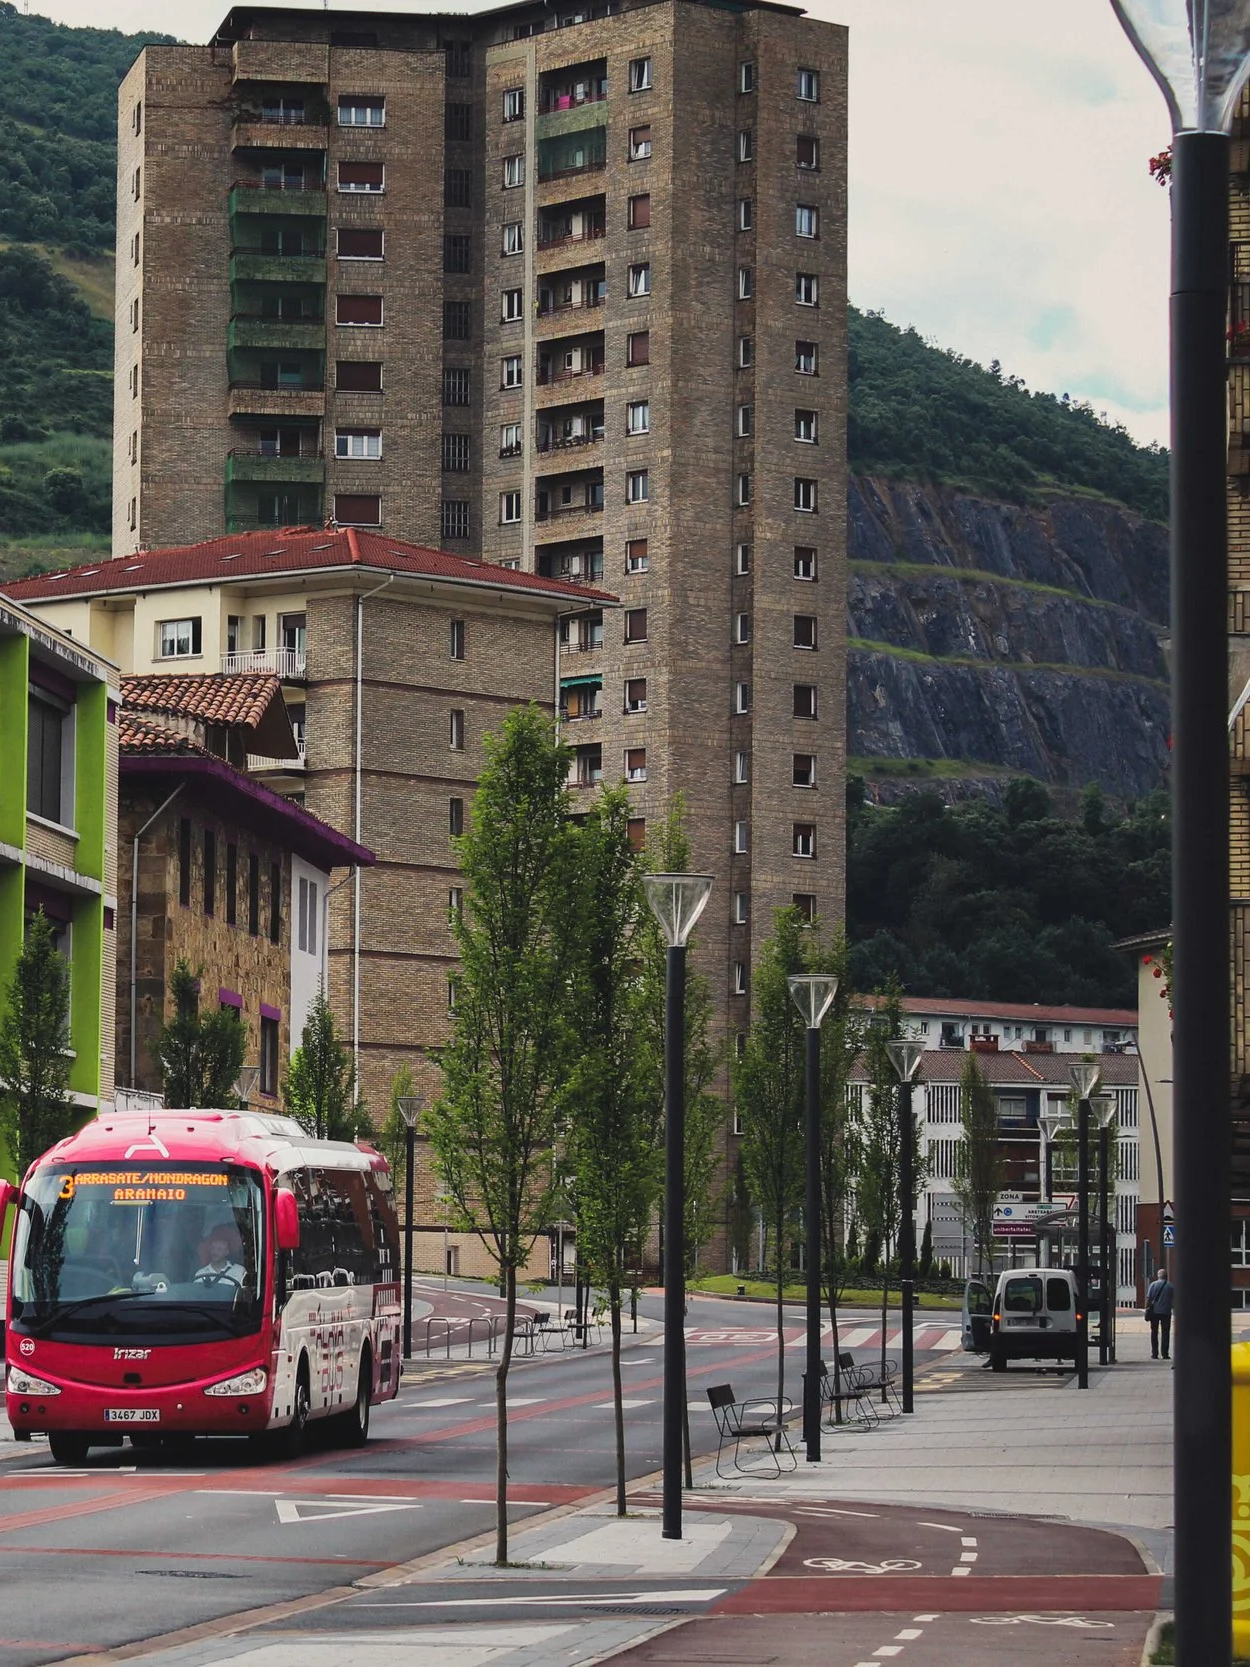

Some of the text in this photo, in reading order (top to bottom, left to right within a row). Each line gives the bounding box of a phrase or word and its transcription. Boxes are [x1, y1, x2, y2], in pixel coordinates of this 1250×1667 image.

[74, 1172, 229, 1186] ARRASATE/MONDRAGON
[58, 1175, 75, 1199] 3
[114, 1188, 186, 1200] ARAMAIO
[21, 1343, 35, 1351] 520
[111, 1410, 158, 1420] 3467 JDX
